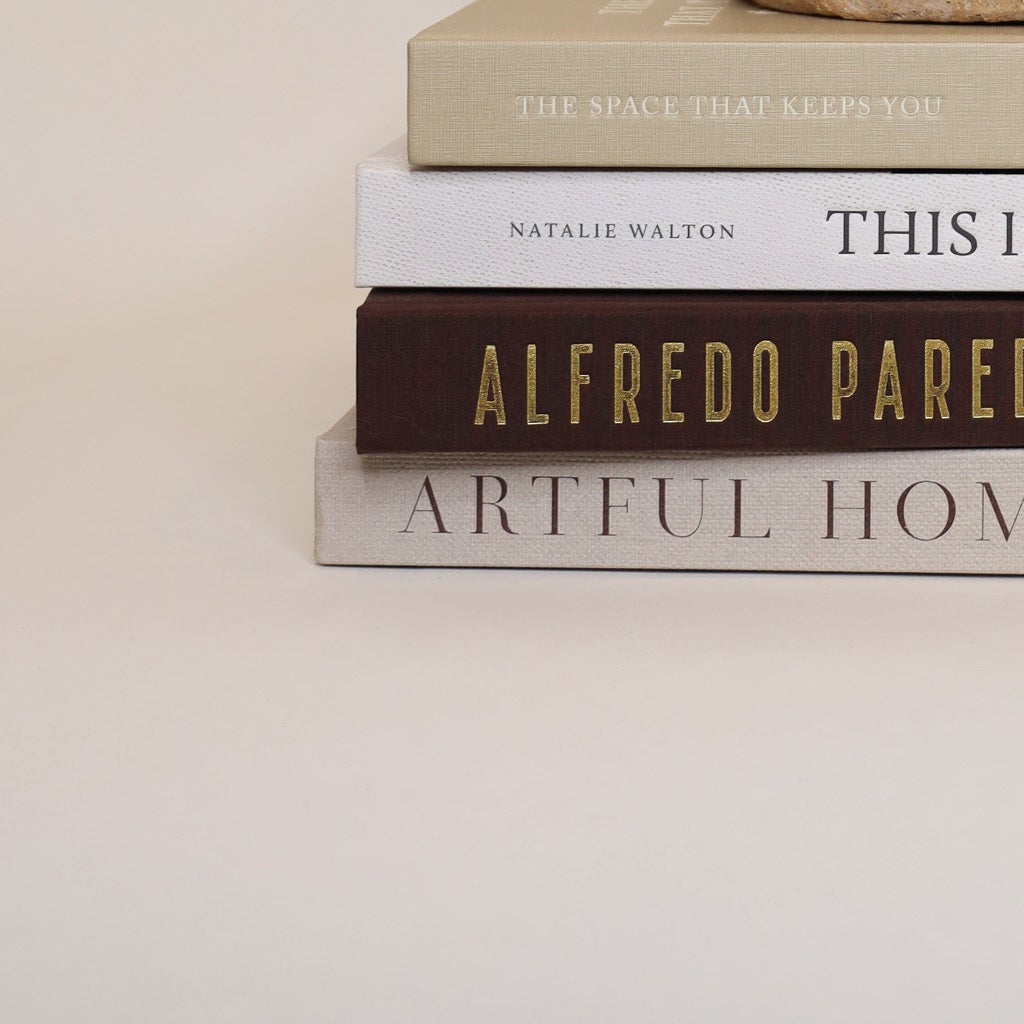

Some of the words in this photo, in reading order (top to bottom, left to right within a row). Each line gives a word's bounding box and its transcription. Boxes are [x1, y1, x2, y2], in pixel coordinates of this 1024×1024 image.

[516, 95, 579, 115] THE
[590, 95, 680, 115] SPACE
[689, 95, 771, 116] THAT
[782, 95, 871, 116] KEEPS
[882, 95, 943, 116] YOU
[510, 222, 616, 239] NATALIE
[628, 223, 735, 240] WALTON
[825, 210, 978, 257] THIS
[473, 339, 781, 426] ALFREDO
[400, 474, 772, 539] ARTFUL
